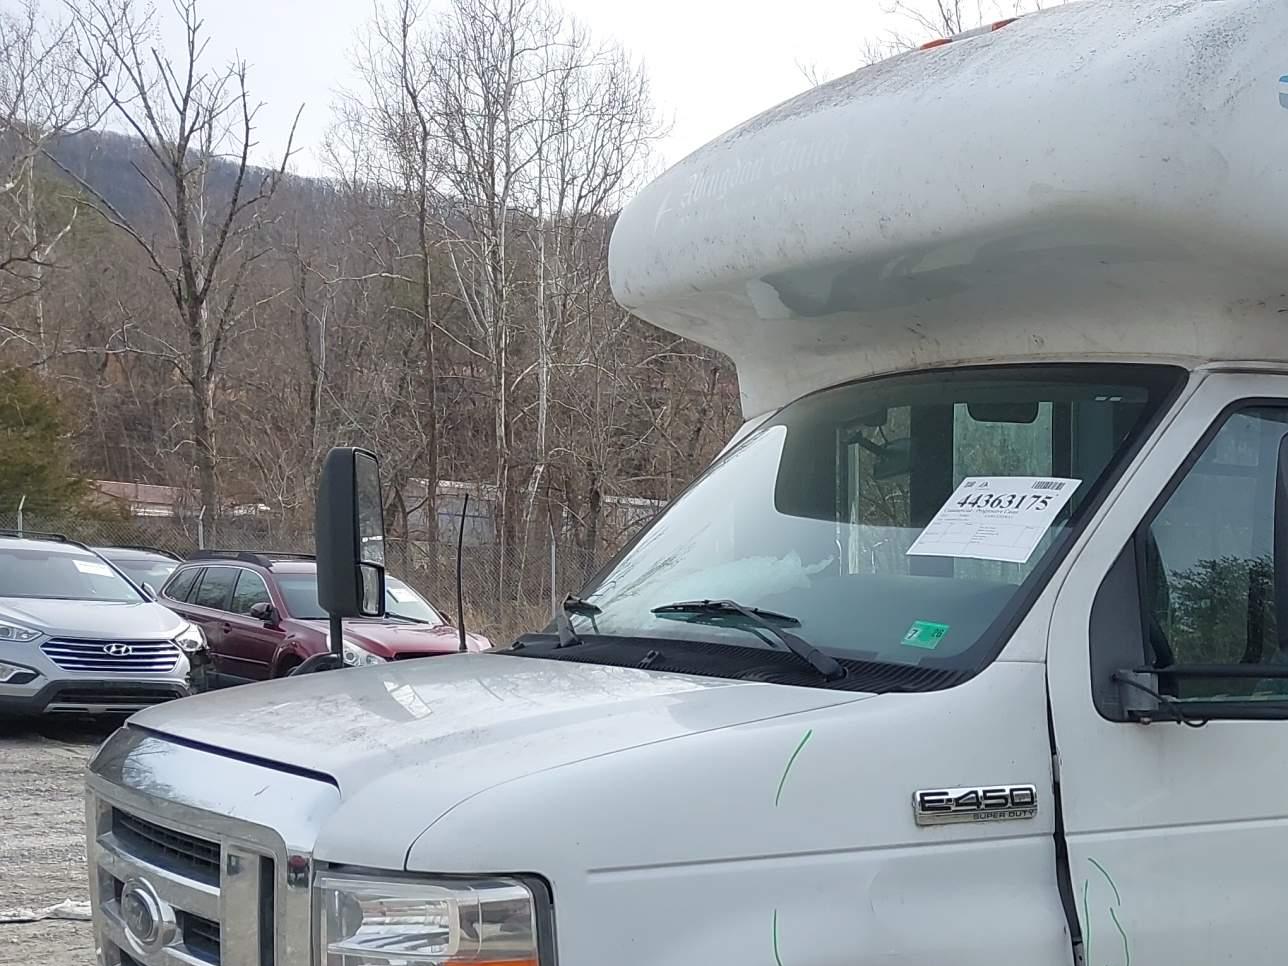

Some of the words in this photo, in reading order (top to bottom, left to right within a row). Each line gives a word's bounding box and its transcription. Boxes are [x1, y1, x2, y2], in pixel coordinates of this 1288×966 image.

[956, 493, 1054, 511] 44363175
[907, 629, 918, 639] 7
[919, 787, 1034, 812] E-450
[973, 812, 1006, 820] SUPER
[1007, 809, 1036, 818] DUTY
